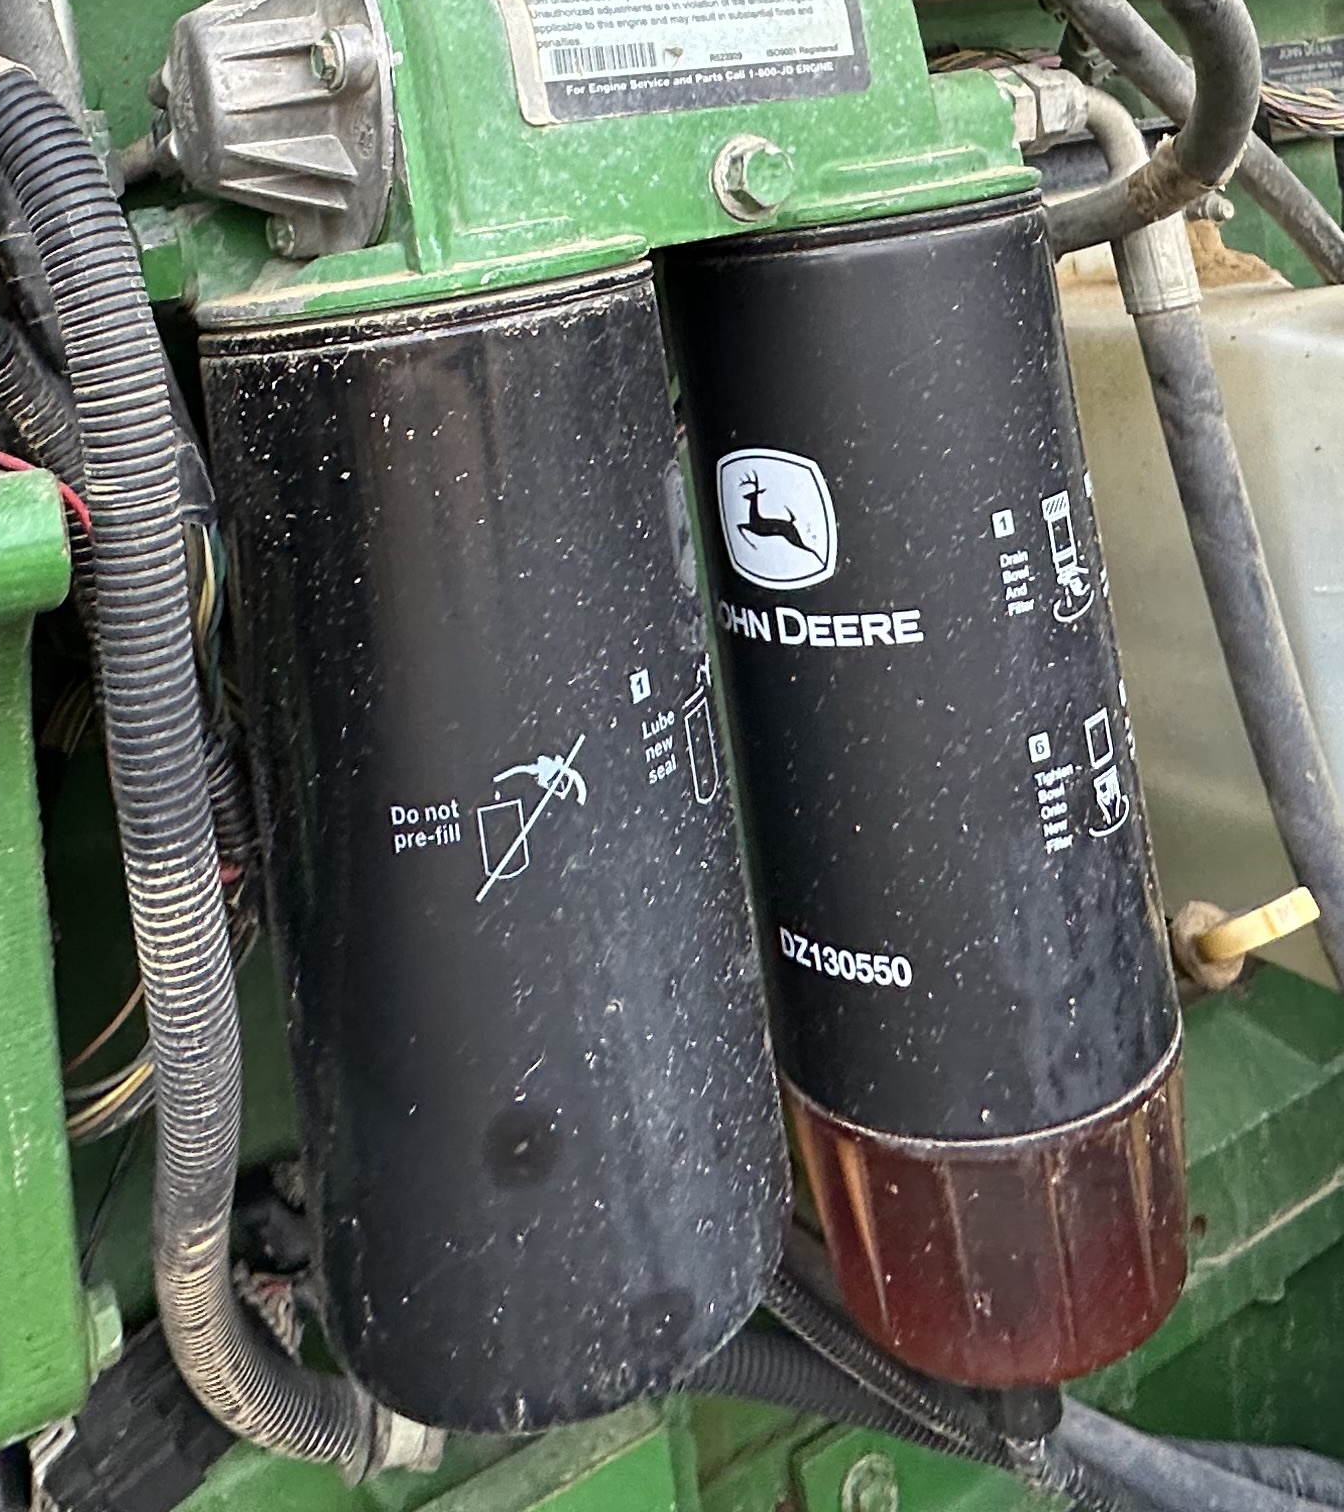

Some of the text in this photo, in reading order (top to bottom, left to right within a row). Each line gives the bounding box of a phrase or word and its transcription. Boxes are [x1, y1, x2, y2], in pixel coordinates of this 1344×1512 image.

[650, 16, 668, 26] and
[670, 15, 689, 26] may
[566, 84, 586, 96] For
[588, 81, 627, 95] Engine
[629, 78, 670, 90] Service
[673, 74, 693, 86] and
[695, 72, 724, 84] Parts
[724, 69, 746, 81] Call
[795, 61, 834, 75] ENGINE
[1000, 550, 1029, 568] Drain
[1002, 565, 1030, 585] Bowl
[1005, 582, 1028, 601] And
[717, 599, 925, 648] OHN DEERE
[641, 710, 675, 740] Lube
[645, 734, 673, 763] new
[648, 753, 677, 785] seal
[1038, 782, 1065, 805] Bowl
[390, 799, 460, 826] Do not
[1040, 801, 1068, 820] Onto
[394, 822, 461, 854] pre-fill
[1043, 819, 1068, 838] New
[779, 925, 913, 988] DZ130550
